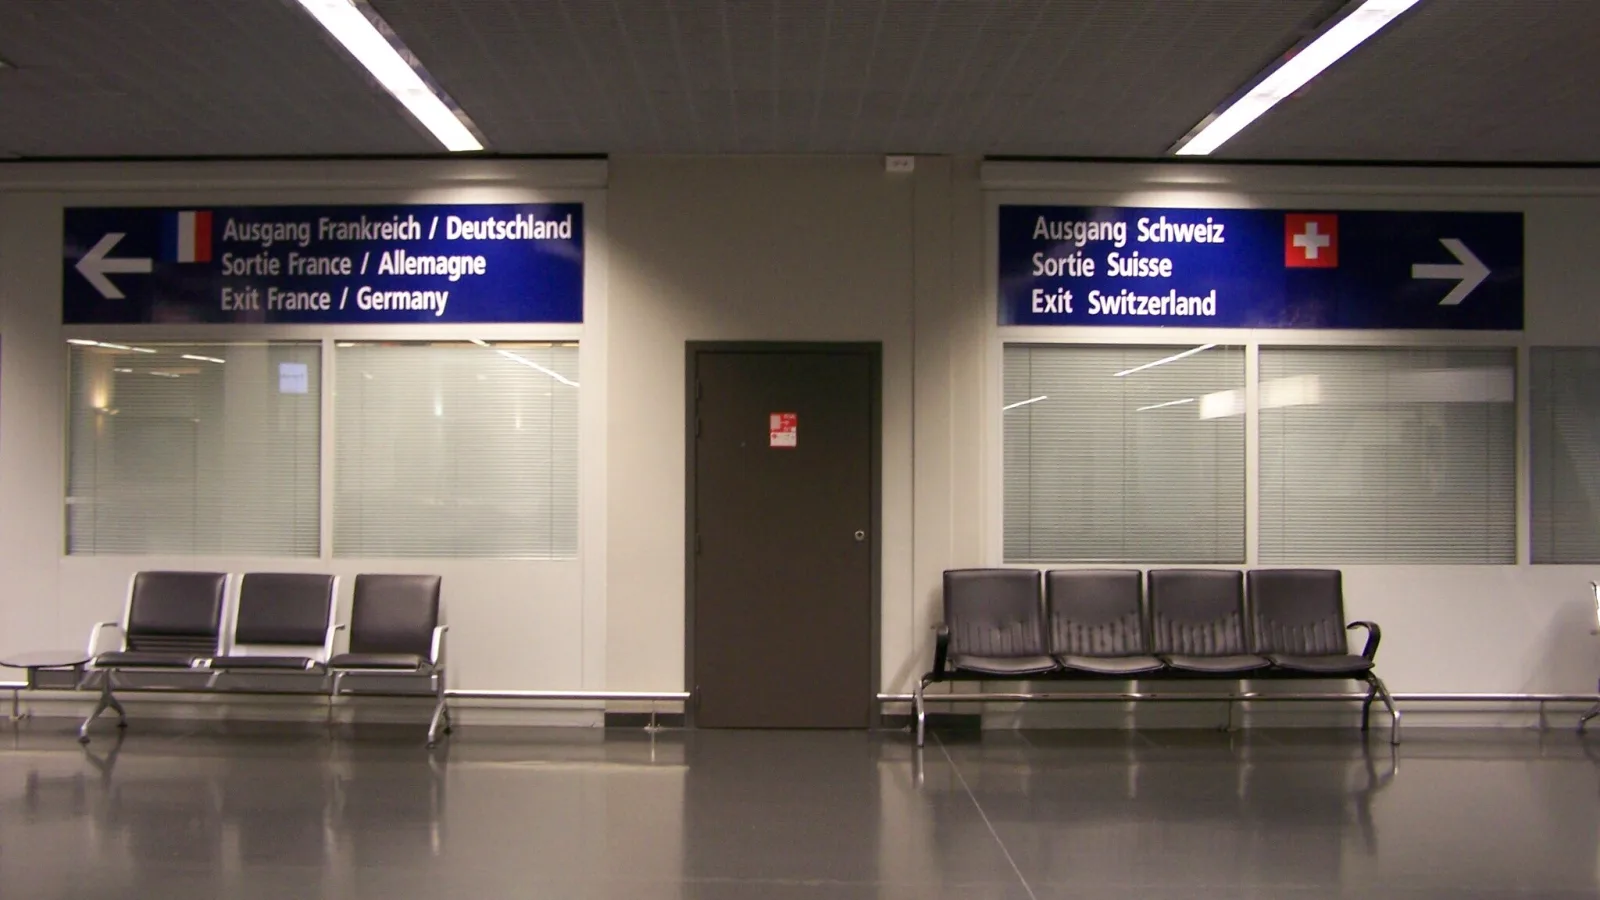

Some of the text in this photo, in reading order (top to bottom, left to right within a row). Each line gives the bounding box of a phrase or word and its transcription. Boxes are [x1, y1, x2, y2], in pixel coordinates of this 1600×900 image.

[222, 214, 571, 247] Ausgang Frankreich / Deutschland
[1034, 216, 1224, 248] Ausgang Schweiz
[222, 250, 486, 281] Sortie France / Allemagne
[1033, 251, 1172, 277] Sortie Suisse
[222, 286, 448, 316] Exit France / Germany
[1033, 288, 1216, 316] Exit Switzerland
